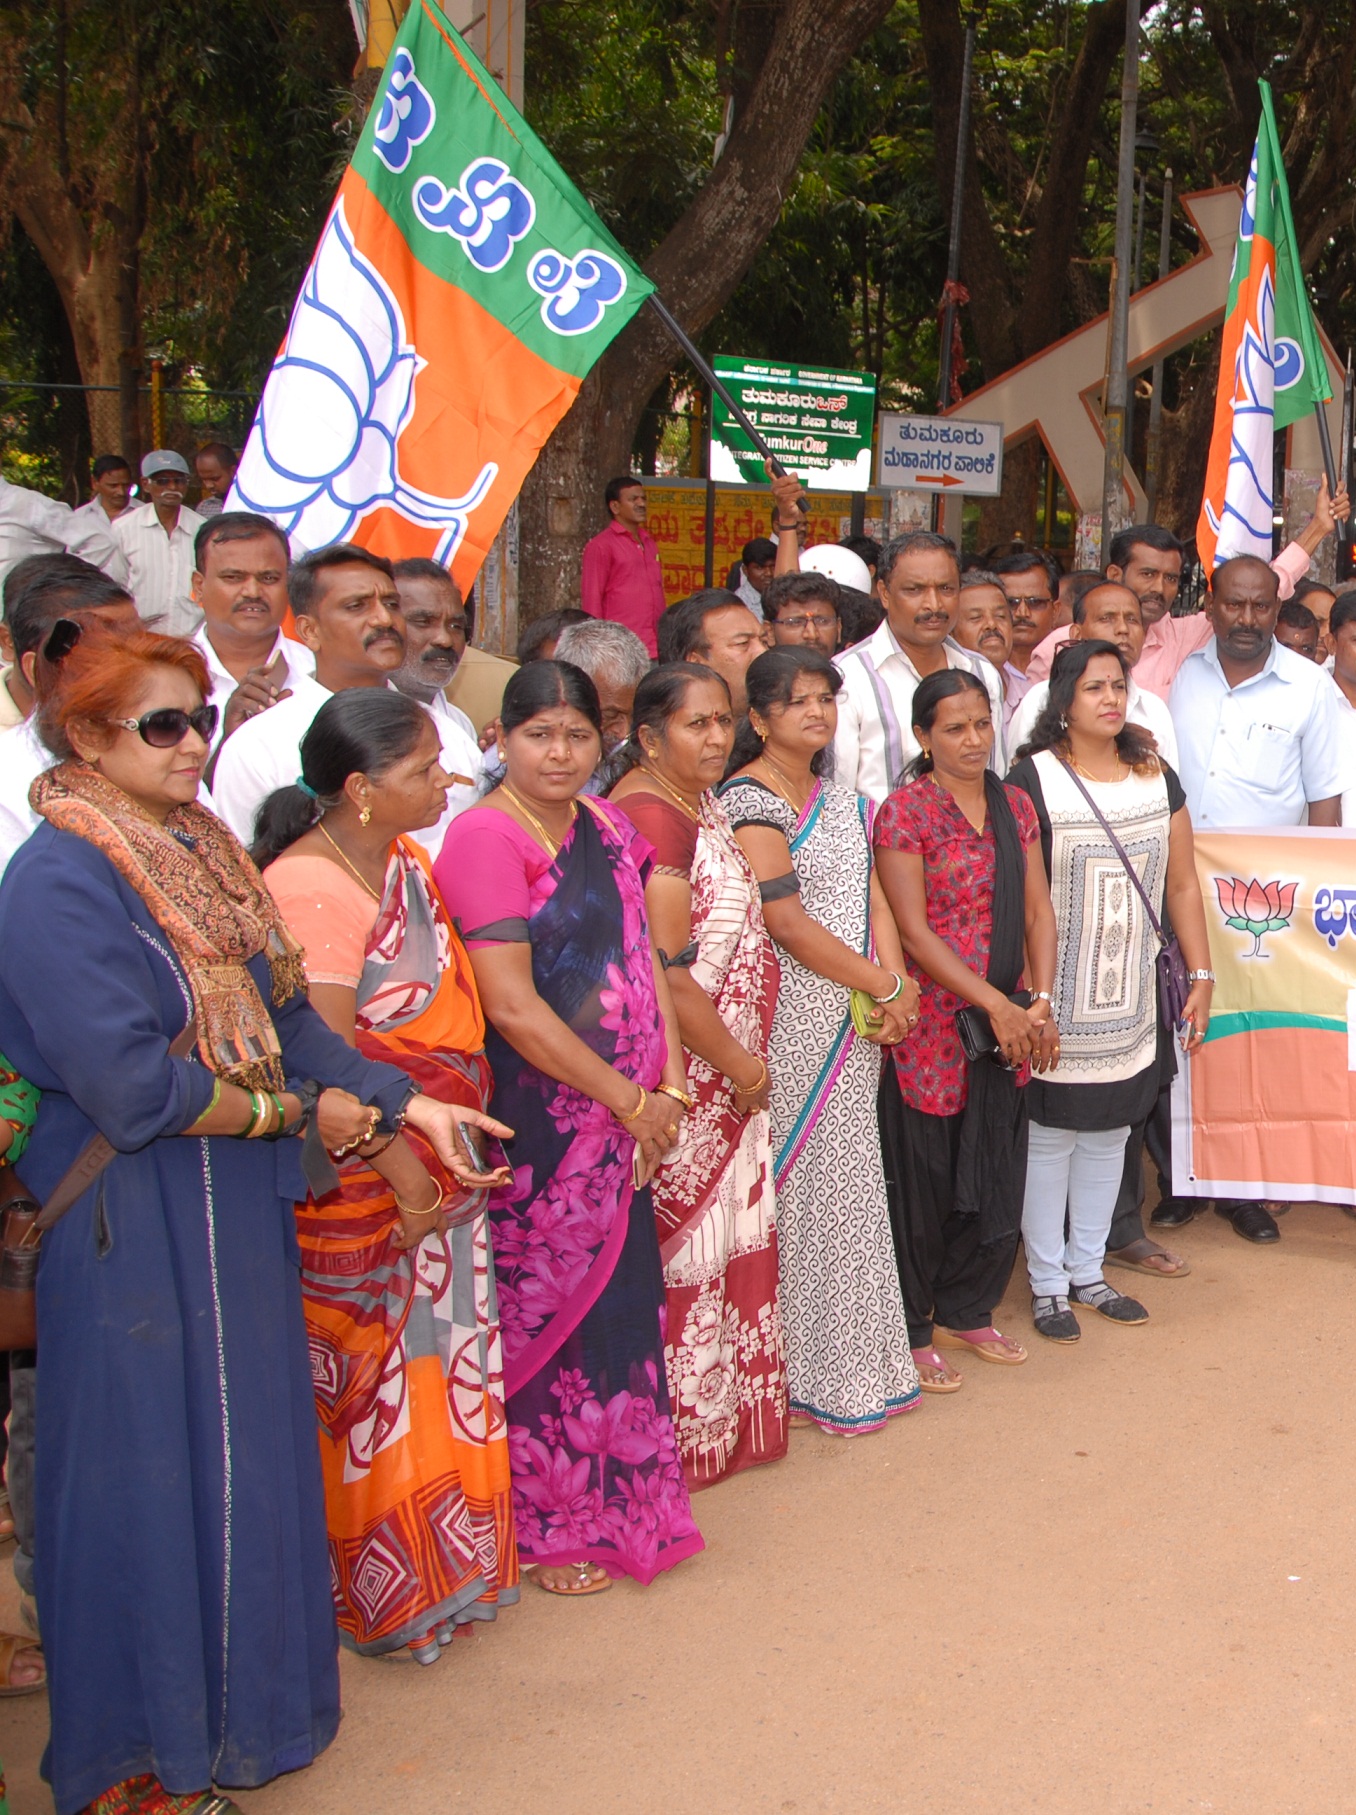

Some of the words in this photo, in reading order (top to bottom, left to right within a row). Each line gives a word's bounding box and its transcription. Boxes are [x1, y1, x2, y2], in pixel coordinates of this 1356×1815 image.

[899, 423, 984, 445] ತುಮಕೂರು
[800, 456, 829, 466] SERVICE
[884, 446, 952, 471] ಮಹಾನಗರ
[954, 453, 996, 474] ಪಾಲಿಕೆ
